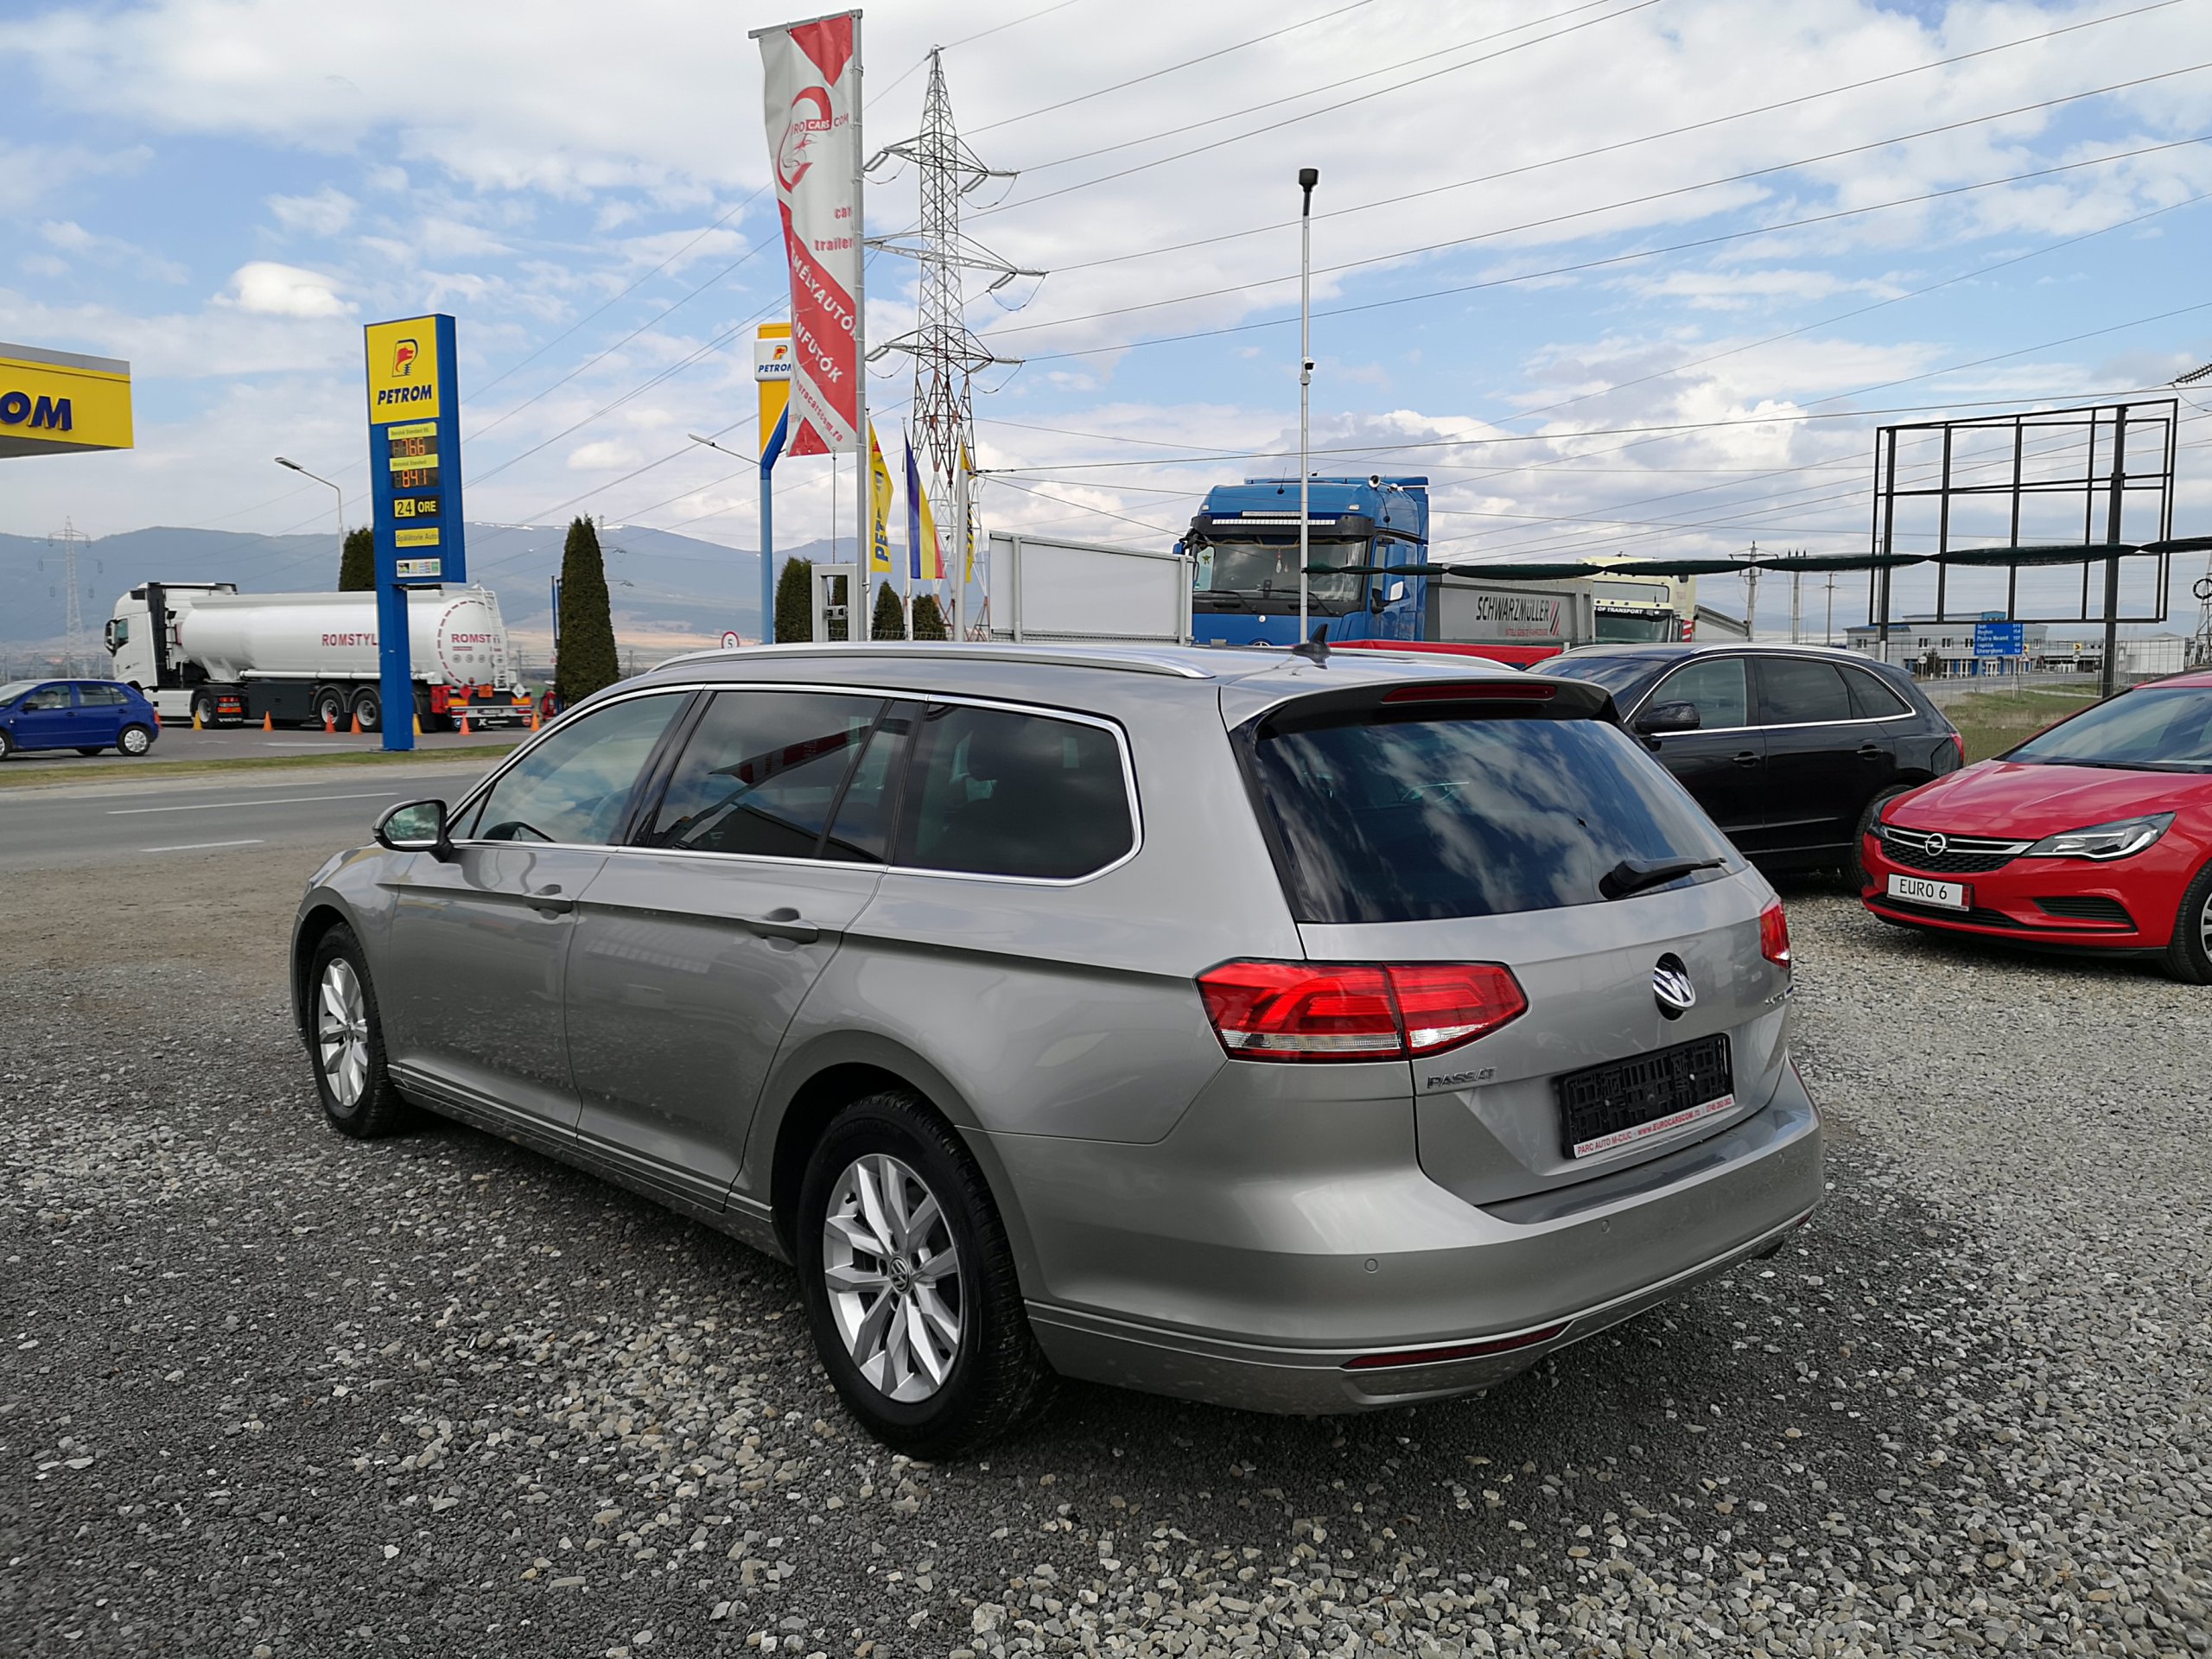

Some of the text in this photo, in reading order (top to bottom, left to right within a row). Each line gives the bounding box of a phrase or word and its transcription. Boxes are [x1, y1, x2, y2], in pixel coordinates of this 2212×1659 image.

[808, 120, 830, 130] CARS
[377, 384, 432, 405] PETROM
[402, 438, 425, 456] 766
[402, 469, 427, 487] 841
[397, 501, 436, 515] 24 ORE
[1476, 595, 1549, 621] SCHWARZMÜLLER
[321, 633, 379, 646] ROMSTYL
[1899, 878, 1948, 900] EURO 6
[1427, 1066, 1497, 1089] PASSAT
[1577, 1141, 1594, 1154] PARC
[1594, 1138, 1611, 1149] AUTO
